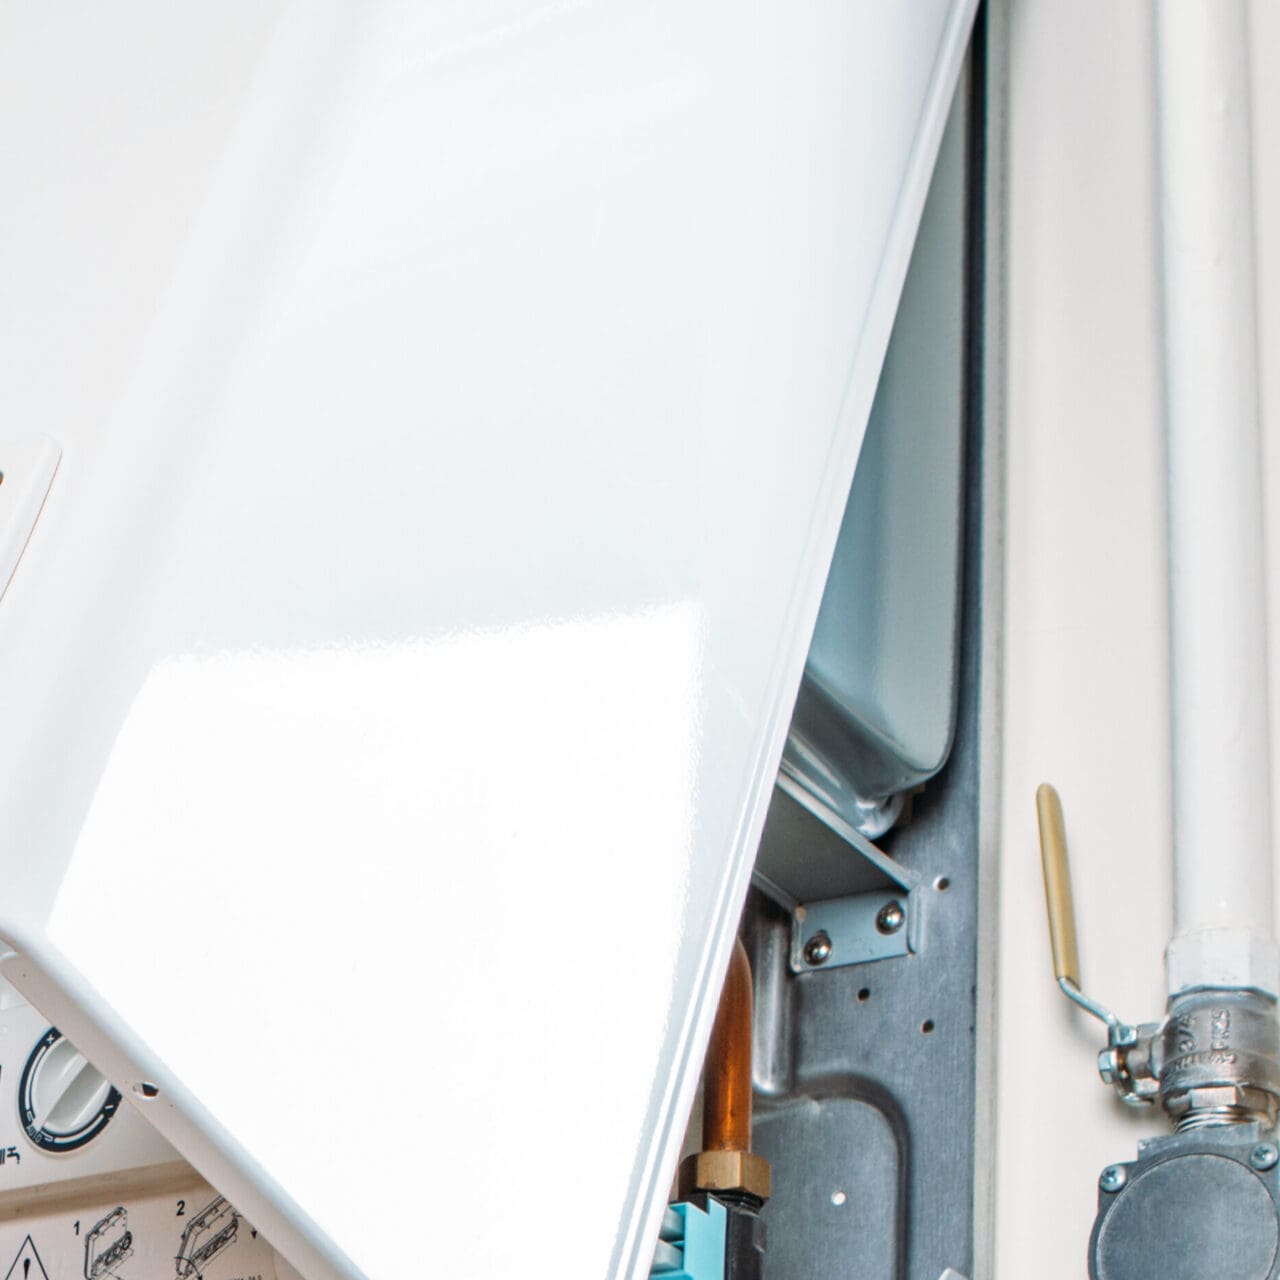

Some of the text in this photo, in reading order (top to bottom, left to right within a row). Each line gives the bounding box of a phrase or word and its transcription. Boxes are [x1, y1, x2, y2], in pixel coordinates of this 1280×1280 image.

[26, 1125, 42, 1143] AUTO
[176, 1200, 186, 1216] 2
[73, 1220, 81, 1236] 1
